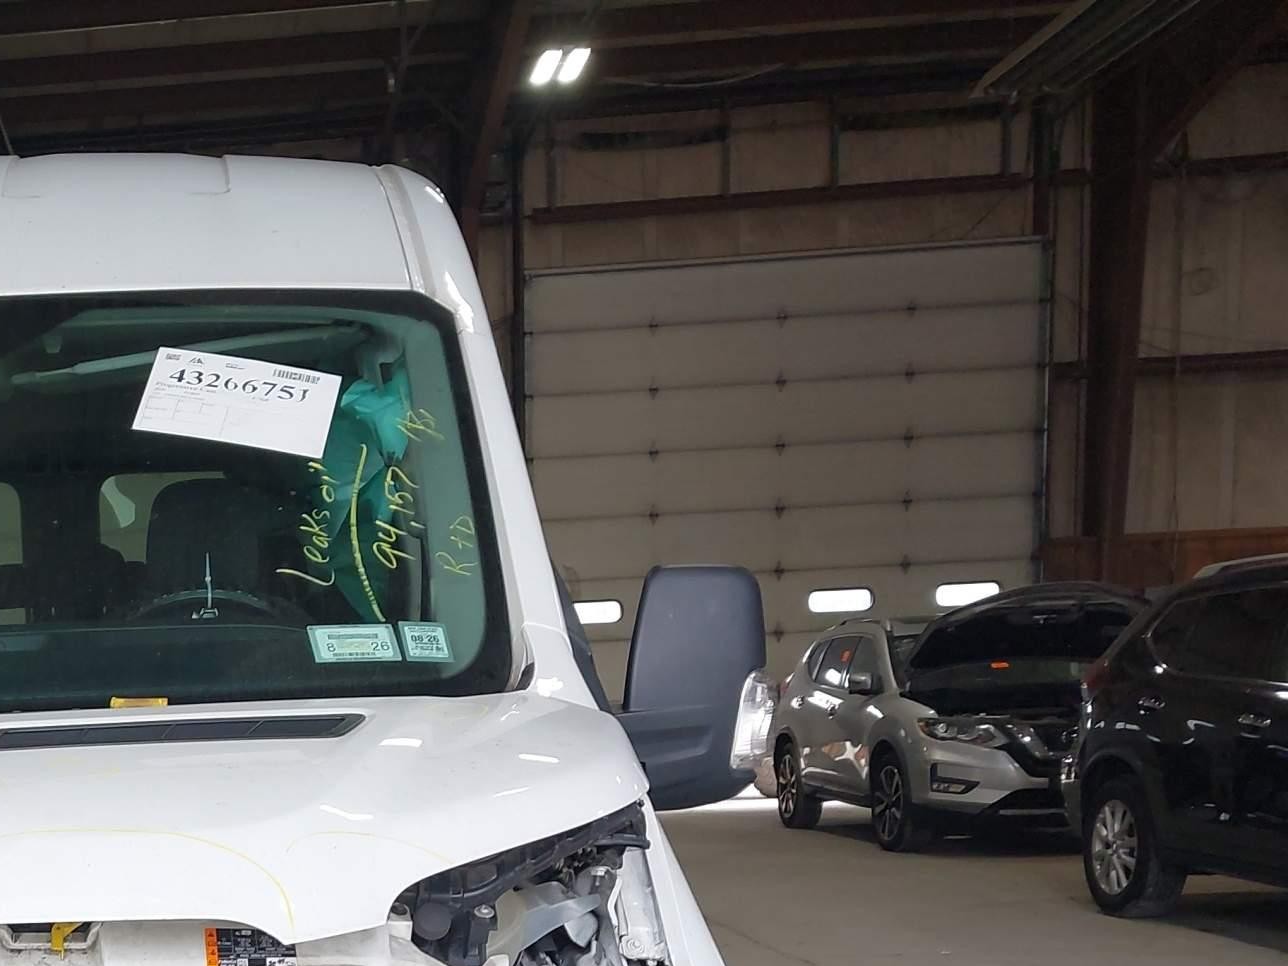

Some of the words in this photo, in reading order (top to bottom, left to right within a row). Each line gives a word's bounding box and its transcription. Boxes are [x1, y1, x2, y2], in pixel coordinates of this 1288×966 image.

[168, 368, 310, 403] 43266751
[326, 642, 337, 653] 8
[371, 641, 391, 652] 26
